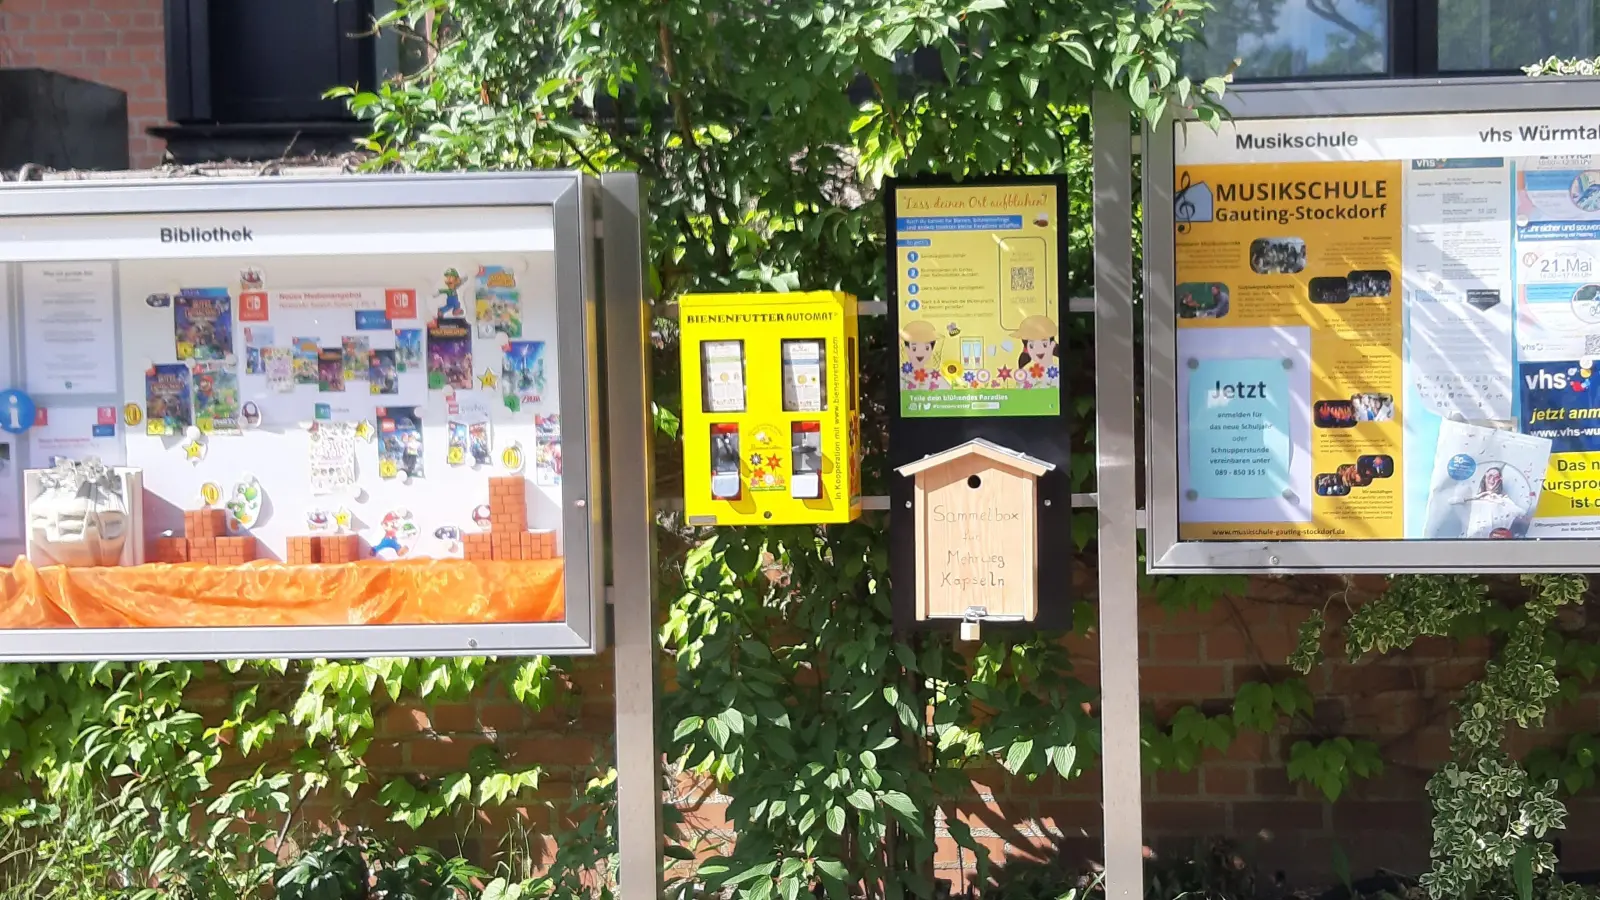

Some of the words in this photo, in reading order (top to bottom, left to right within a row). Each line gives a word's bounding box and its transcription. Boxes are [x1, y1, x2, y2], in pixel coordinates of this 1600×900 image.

[1236, 131, 1358, 149] Musikschule
[1479, 127, 1512, 143] vhs
[1216, 180, 1388, 201] MUSIKSCHULE
[1215, 203, 1388, 224] Gauting-Stockdorf
[160, 226, 253, 243] Bibliothek
[1525, 369, 1567, 390] vhs
[1212, 380, 1267, 399] Jetzt
[1217, 411, 1251, 419] anmelden
[1252, 410, 1262, 418] für
[1529, 407, 1564, 424] jetzt
[1241, 423, 1273, 432] Schuljahr
[1211, 446, 1270, 455] Schnupperstunde
[834, 442, 843, 490] Kooperation
[1557, 459, 1585, 472] Das
[1541, 478, 1600, 492] urspro
[1571, 496, 1590, 508] ist
[933, 504, 1019, 523] Sammelbox
[946, 549, 1006, 569] Mehrweg
[940, 571, 1005, 591] Kapseln
